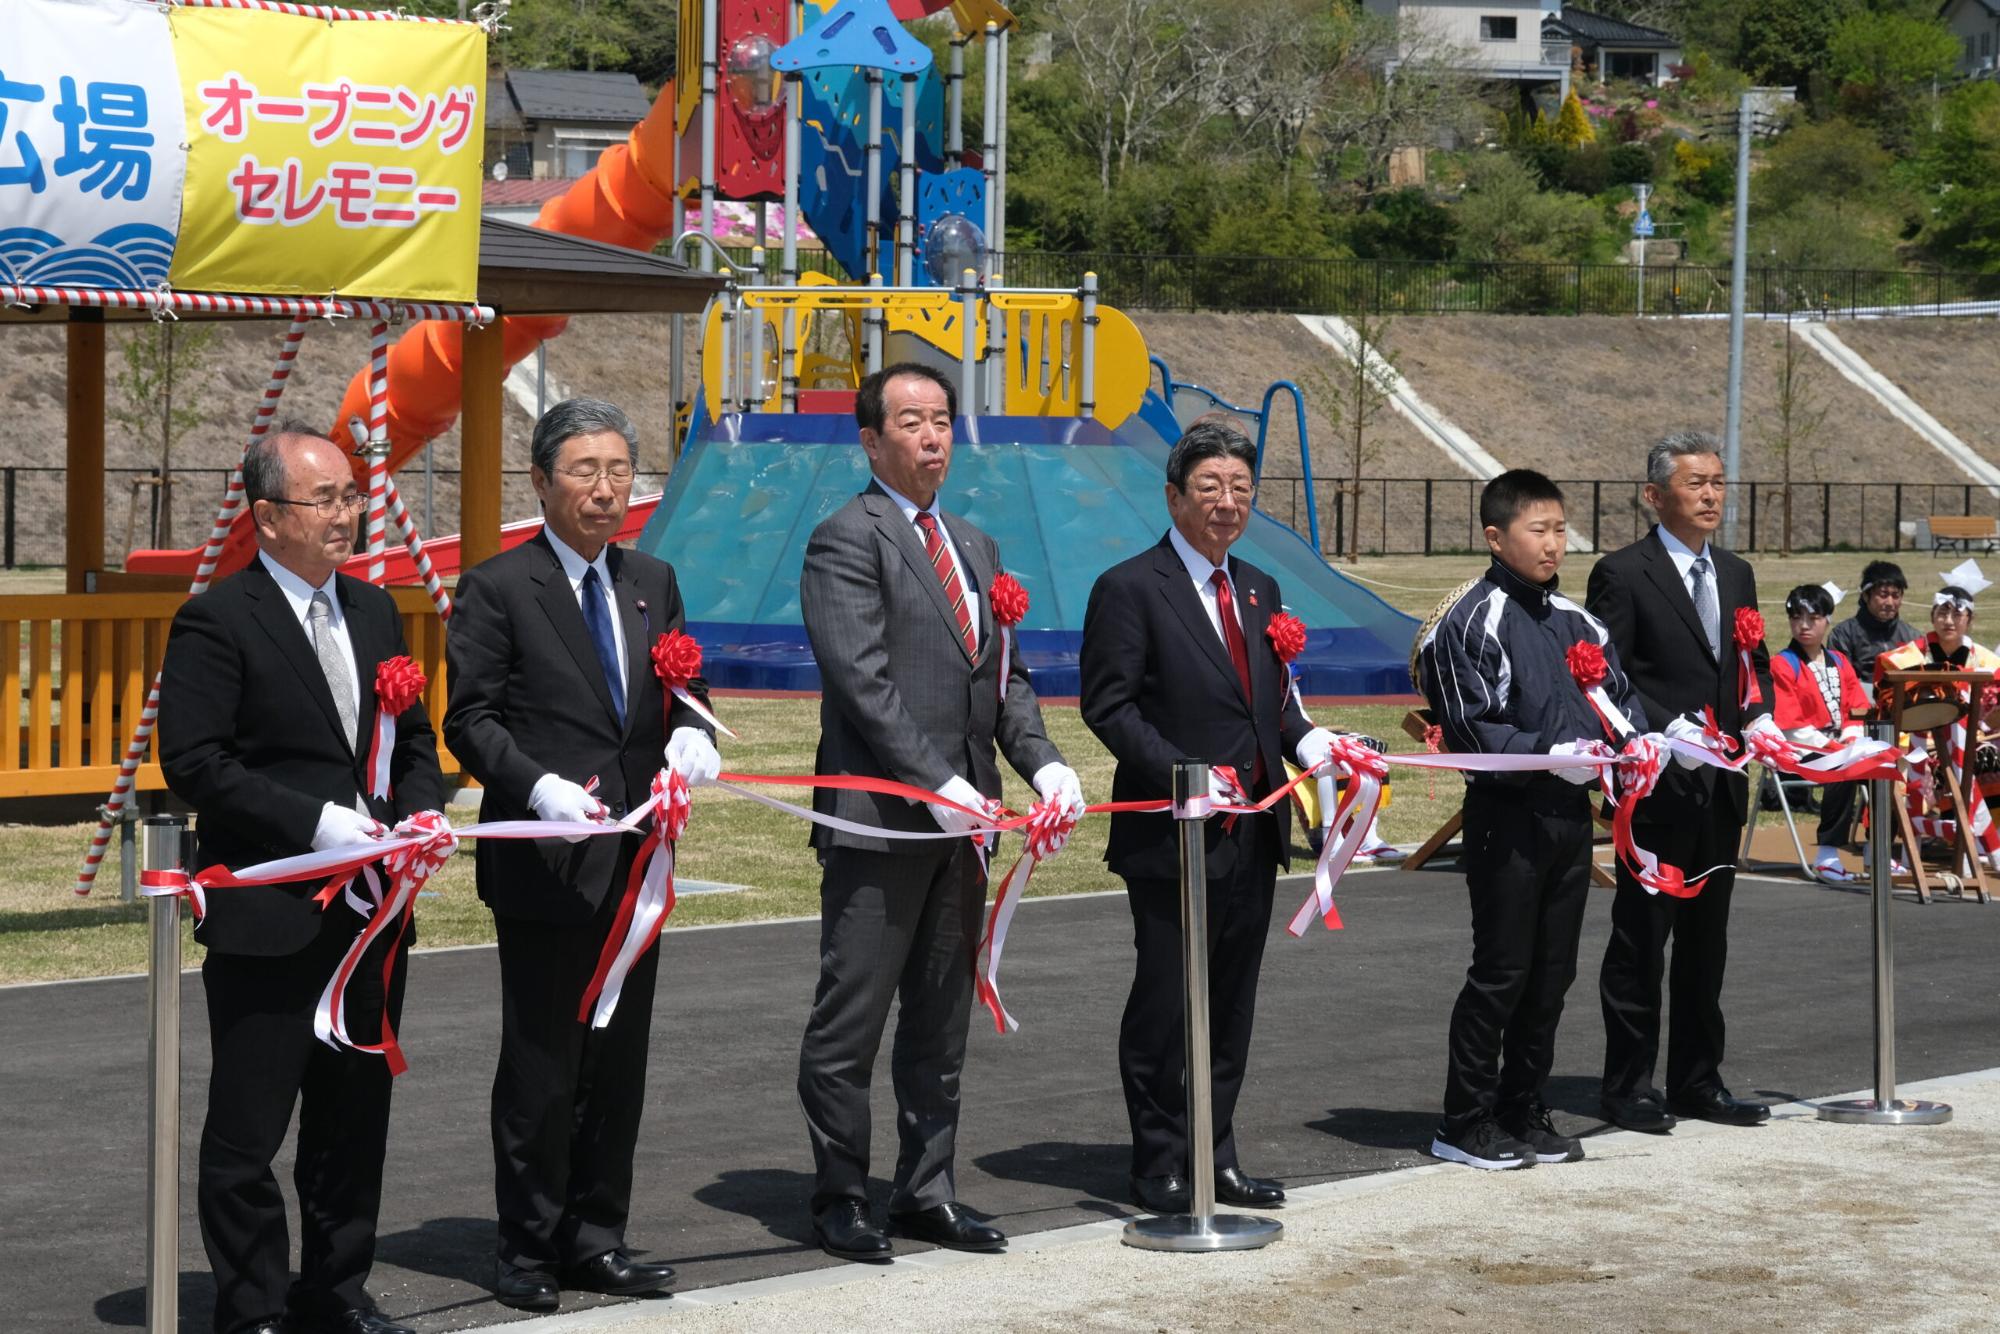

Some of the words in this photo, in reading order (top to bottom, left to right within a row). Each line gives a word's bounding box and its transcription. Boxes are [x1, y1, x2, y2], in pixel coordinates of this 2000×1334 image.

[203, 78, 475, 148] オープニング
[233, 161, 457, 222] セレモニー
